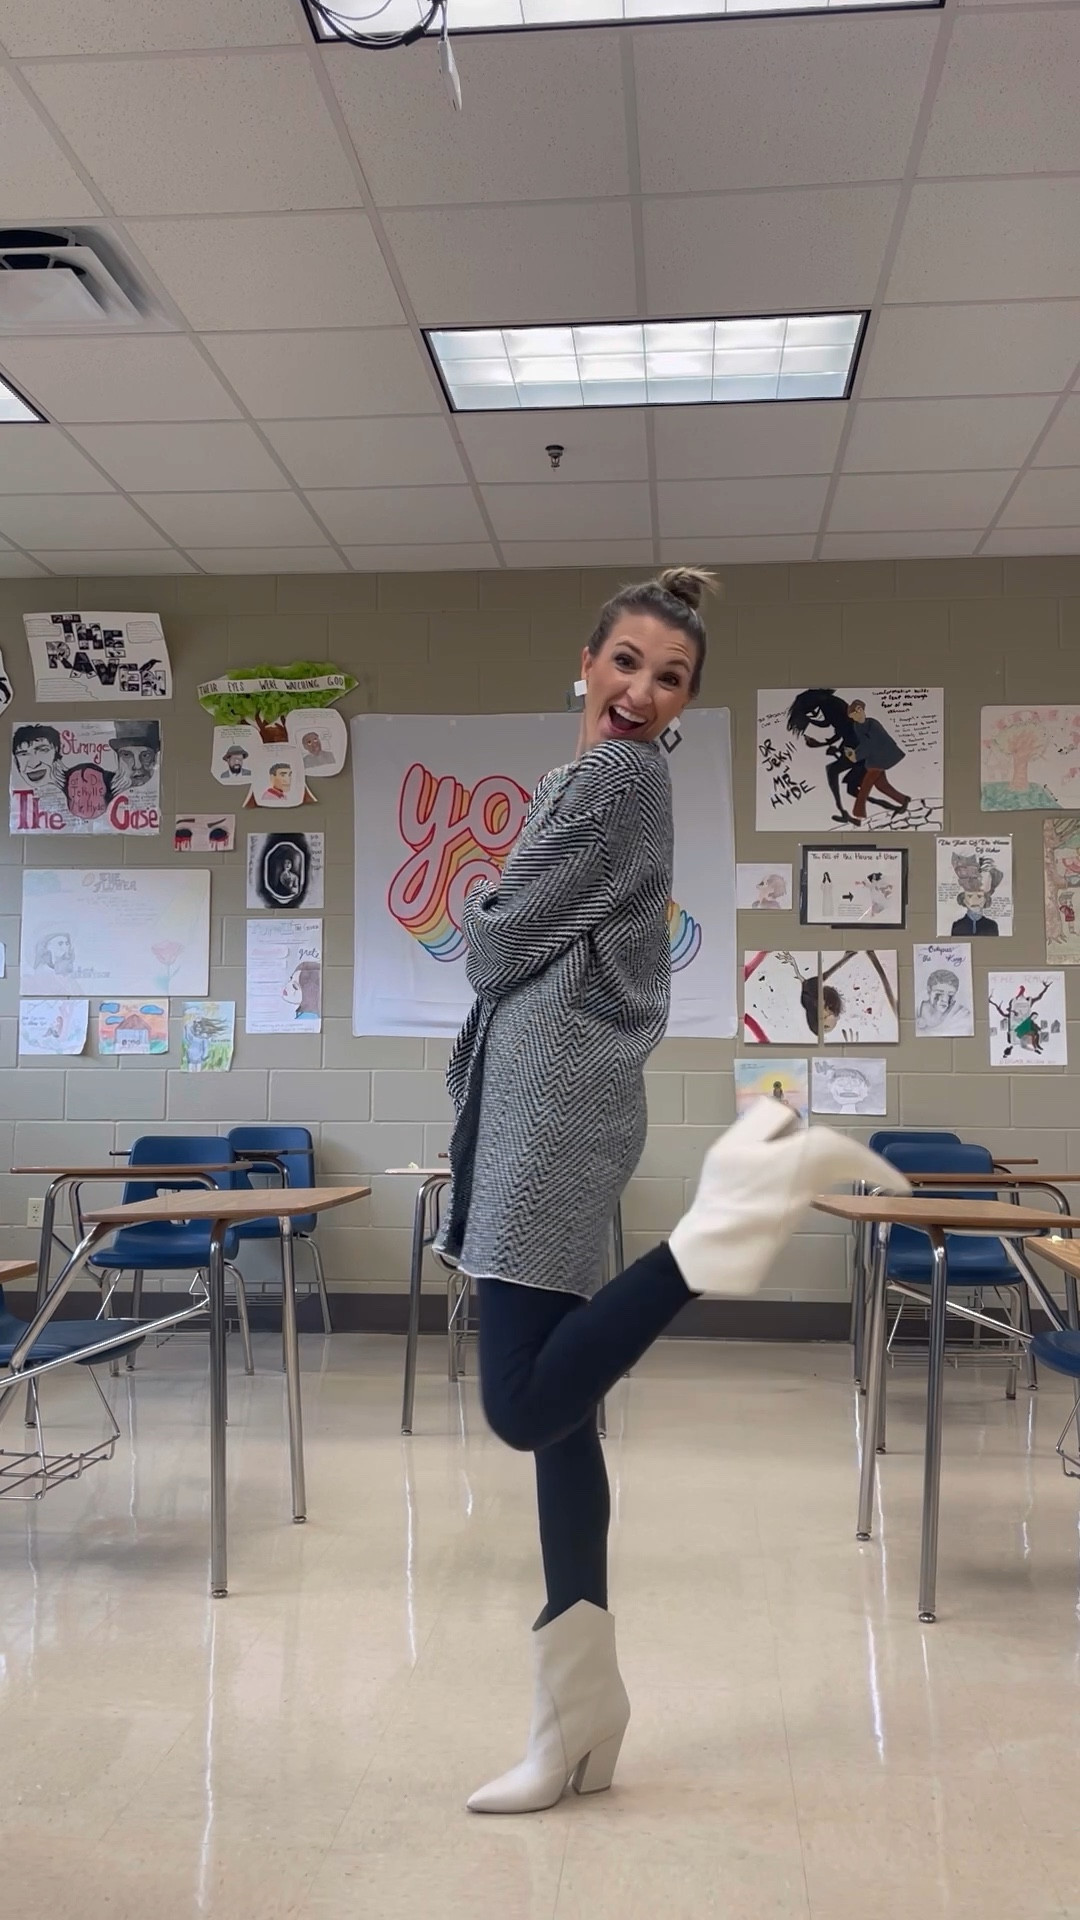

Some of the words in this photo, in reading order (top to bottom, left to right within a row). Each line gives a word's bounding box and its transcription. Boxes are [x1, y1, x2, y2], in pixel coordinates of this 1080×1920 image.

[51, 614, 126, 658] THE
[46, 641, 166, 696] RAVEN
[199, 682, 218, 695] THEIR
[228, 681, 245, 692] EYES
[259, 679, 279, 690] WERE
[284, 679, 320, 690] WATCHING
[327, 675, 344, 687] GOD
[62, 730, 111, 764] Strange
[762, 741, 797, 772] Jekyll
[770, 780, 816, 809] HYDE
[773, 773, 798, 793] MR
[13, 789, 67, 830] The
[110, 795, 159, 830] Case
[388, 763, 535, 922] yo
